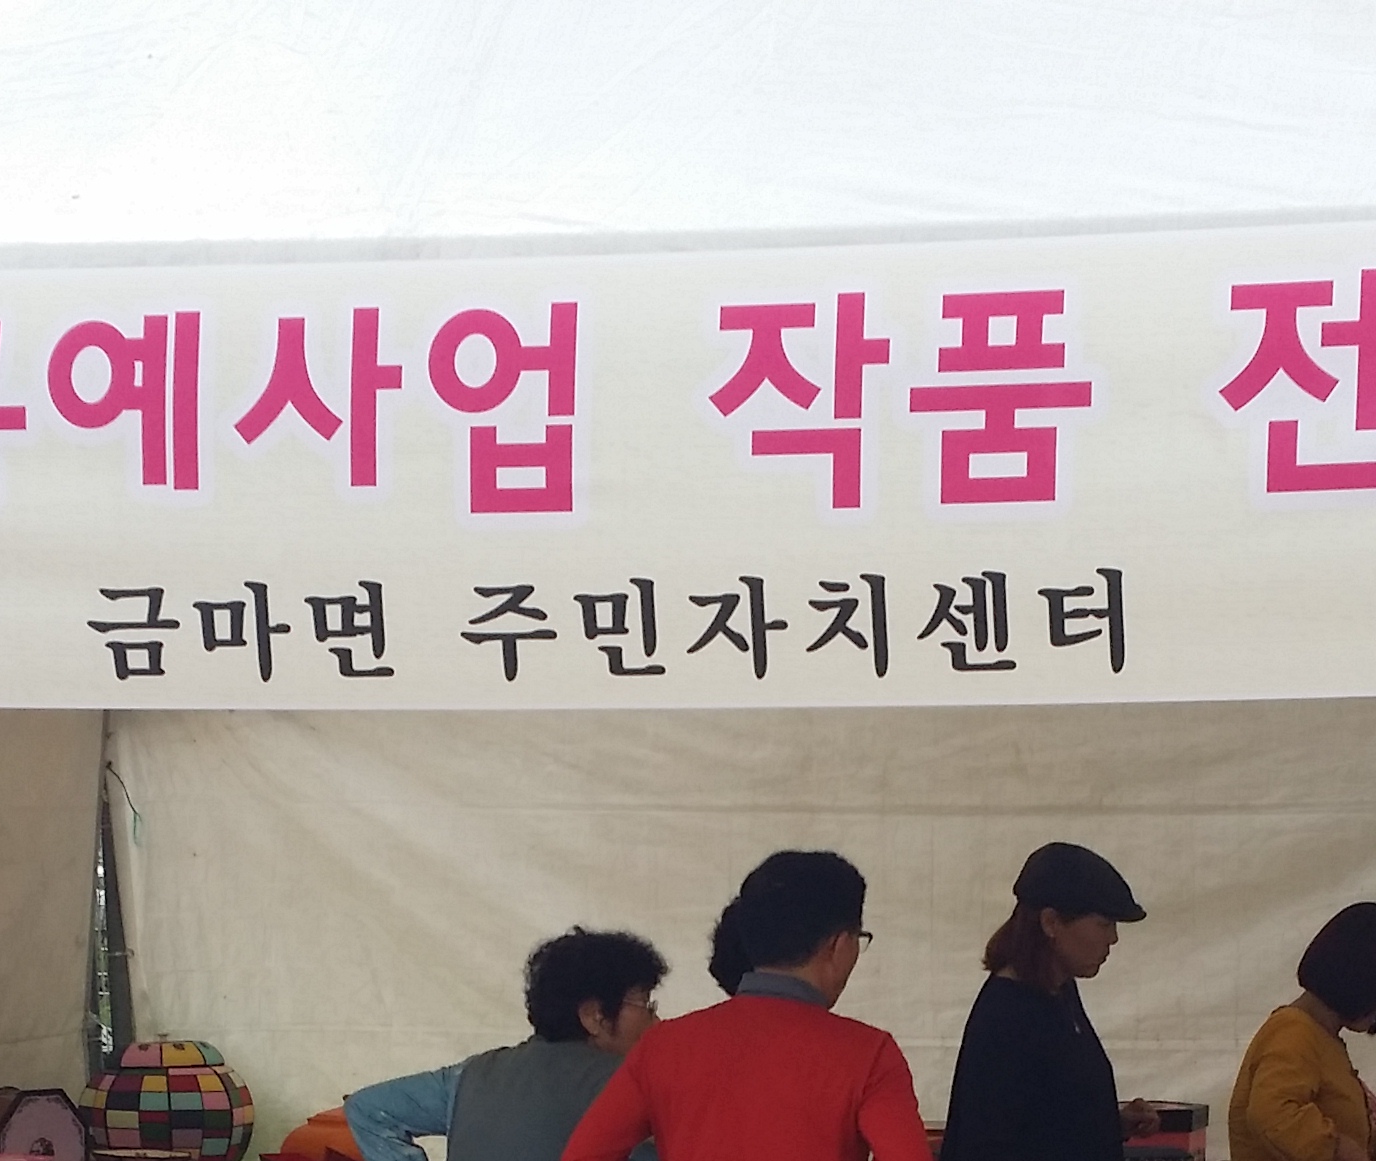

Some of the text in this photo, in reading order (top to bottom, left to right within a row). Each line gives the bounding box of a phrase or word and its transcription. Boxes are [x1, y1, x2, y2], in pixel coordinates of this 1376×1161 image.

[709, 289, 1093, 510] 작품
[87, 568, 1126, 682] 금마면 주민자치센터
